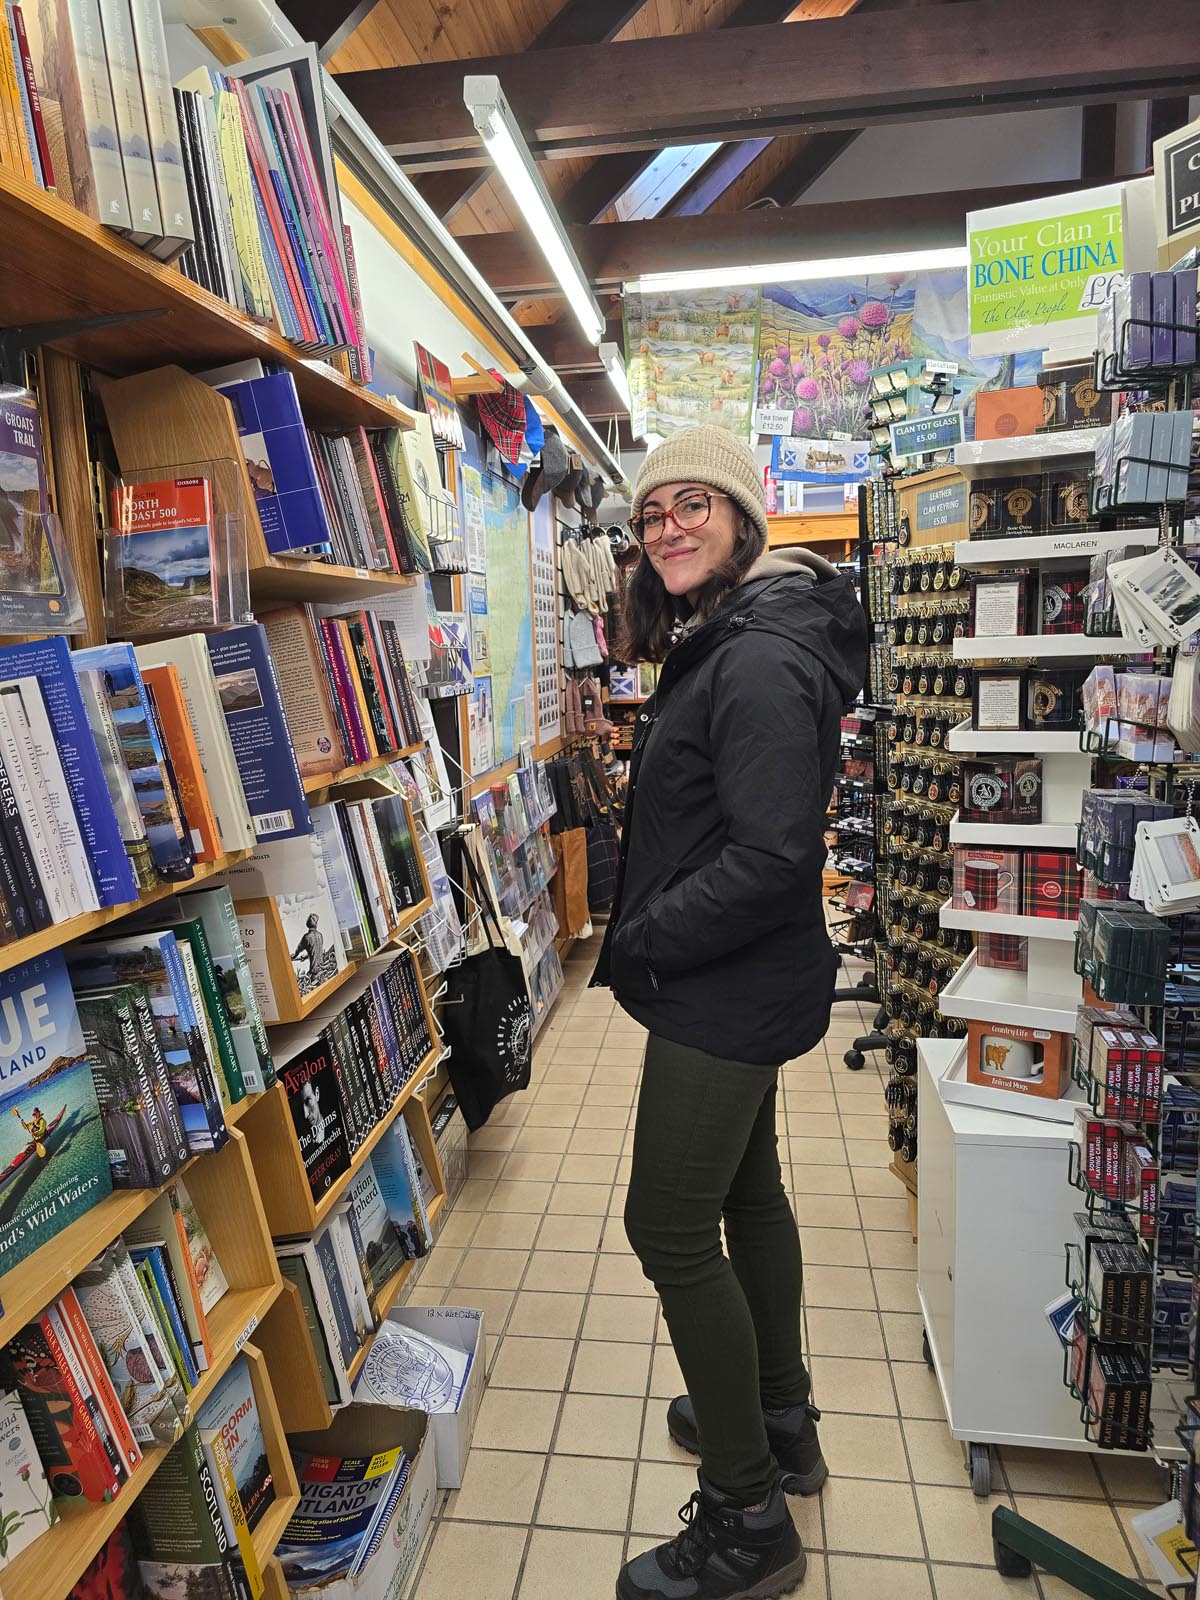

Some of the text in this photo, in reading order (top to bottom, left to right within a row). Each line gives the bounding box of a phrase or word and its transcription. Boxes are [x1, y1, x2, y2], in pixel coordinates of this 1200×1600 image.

[24, 55, 40, 112] THE SKYE TRAIL
[210, 129, 220, 162] LANDSCAPE
[974, 221, 1092, 258] Your Clan
[974, 240, 1117, 288] BONE CHINA
[974, 276, 1086, 304] Fantastic Value at Only
[983, 292, 1068, 326] The Clan People
[4, 412, 35, 432] GROATS
[762, 423, 784, 431] £12.50
[896, 417, 957, 436] CLAN TOT GLASS
[916, 432, 937, 443] £5.00
[13, 430, 36, 448] TRAIL
[923, 502, 959, 516] CLAN KEYRING
[929, 489, 952, 501] LEATHER
[160, 508, 177, 518] 500
[933, 516, 948, 526] £5.00
[1054, 540, 1098, 549] MACLAREN
[384, 628, 398, 668] PARALLAX
[391, 629, 404, 666] PARALLAX
[323, 625, 359, 758] Isa's Daughter Catherine Byrne
[95, 690, 120, 765] In Their Footsteps
[146, 714, 156, 739] WALKS
[265, 654, 308, 801] Scottish Wild Country Backpacking
[7, 738, 40, 839] HIDDEN FIRES
[24, 736, 57, 835] HIDDEN FIRES
[12, 824, 38, 889] KERRI ANDREWS
[1, 857, 18, 897] ANDREWS
[194, 931, 210, 956] LONE
[224, 902, 232, 915] In
[228, 920, 239, 939] the
[234, 942, 250, 977] Hide
[200, 956, 221, 992] FURROW
[181, 952, 210, 1045] RIDERS THE STORM
[137, 1011, 150, 1041] SCOTLAND
[243, 984, 272, 1055] Gordon Buchanan
[992, 1025, 1011, 1037] Country
[1013, 1027, 1028, 1037] Life
[119, 1022, 133, 1053] SCOTLAND
[214, 1002, 240, 1072] ALAN STEWART
[122, 1019, 161, 1125] WILD SWIMMING
[140, 1007, 175, 1111] WILD SWIMMING
[336, 1040, 354, 1096] BROLLACHAN
[343, 1032, 361, 1088] BROLLACHAN
[283, 1055, 327, 1098] Avalon
[992, 1078, 1028, 1091] Animal Mugs
[310, 1110, 337, 1136] Drums
[396, 1133, 418, 1198] The Highland Vet
[21, 1201, 40, 1217] Guide
[48, 1175, 79, 1198] Exploring
[26, 1175, 99, 1231] Wild Waters
[352, 1175, 372, 1199] ation
[355, 1184, 378, 1219] pherd
[170, 1279, 183, 1300] MIRACLE
[54, 1325, 72, 1352] GARDEN
[236, 1317, 258, 1348] WILDLIFE
[67, 1352, 75, 1361] IN
[70, 1361, 81, 1375] THE
[42, 1323, 97, 1440] FOLK TALES FROM THE GARDEN
[71, 1313, 128, 1440] ROBIN WALL KIMMERER BRAIDING SWEETGRASS
[76, 1375, 91, 1395] HILLS
[367, 1362, 388, 1396] JAMAIS
[220, 1397, 253, 1437] GORM
[1107, 1392, 1116, 1413] CARDS
[1122, 1390, 1131, 1412] CARDS
[99, 1434, 115, 1457] STEWART
[370, 1462, 389, 1470] SELLER
[301, 1475, 383, 1499] VIGATOR
[200, 1468, 226, 1554] SCOTLAND
[229, 1496, 239, 1526] PLACES
[339, 1511, 363, 1523] Scotland
